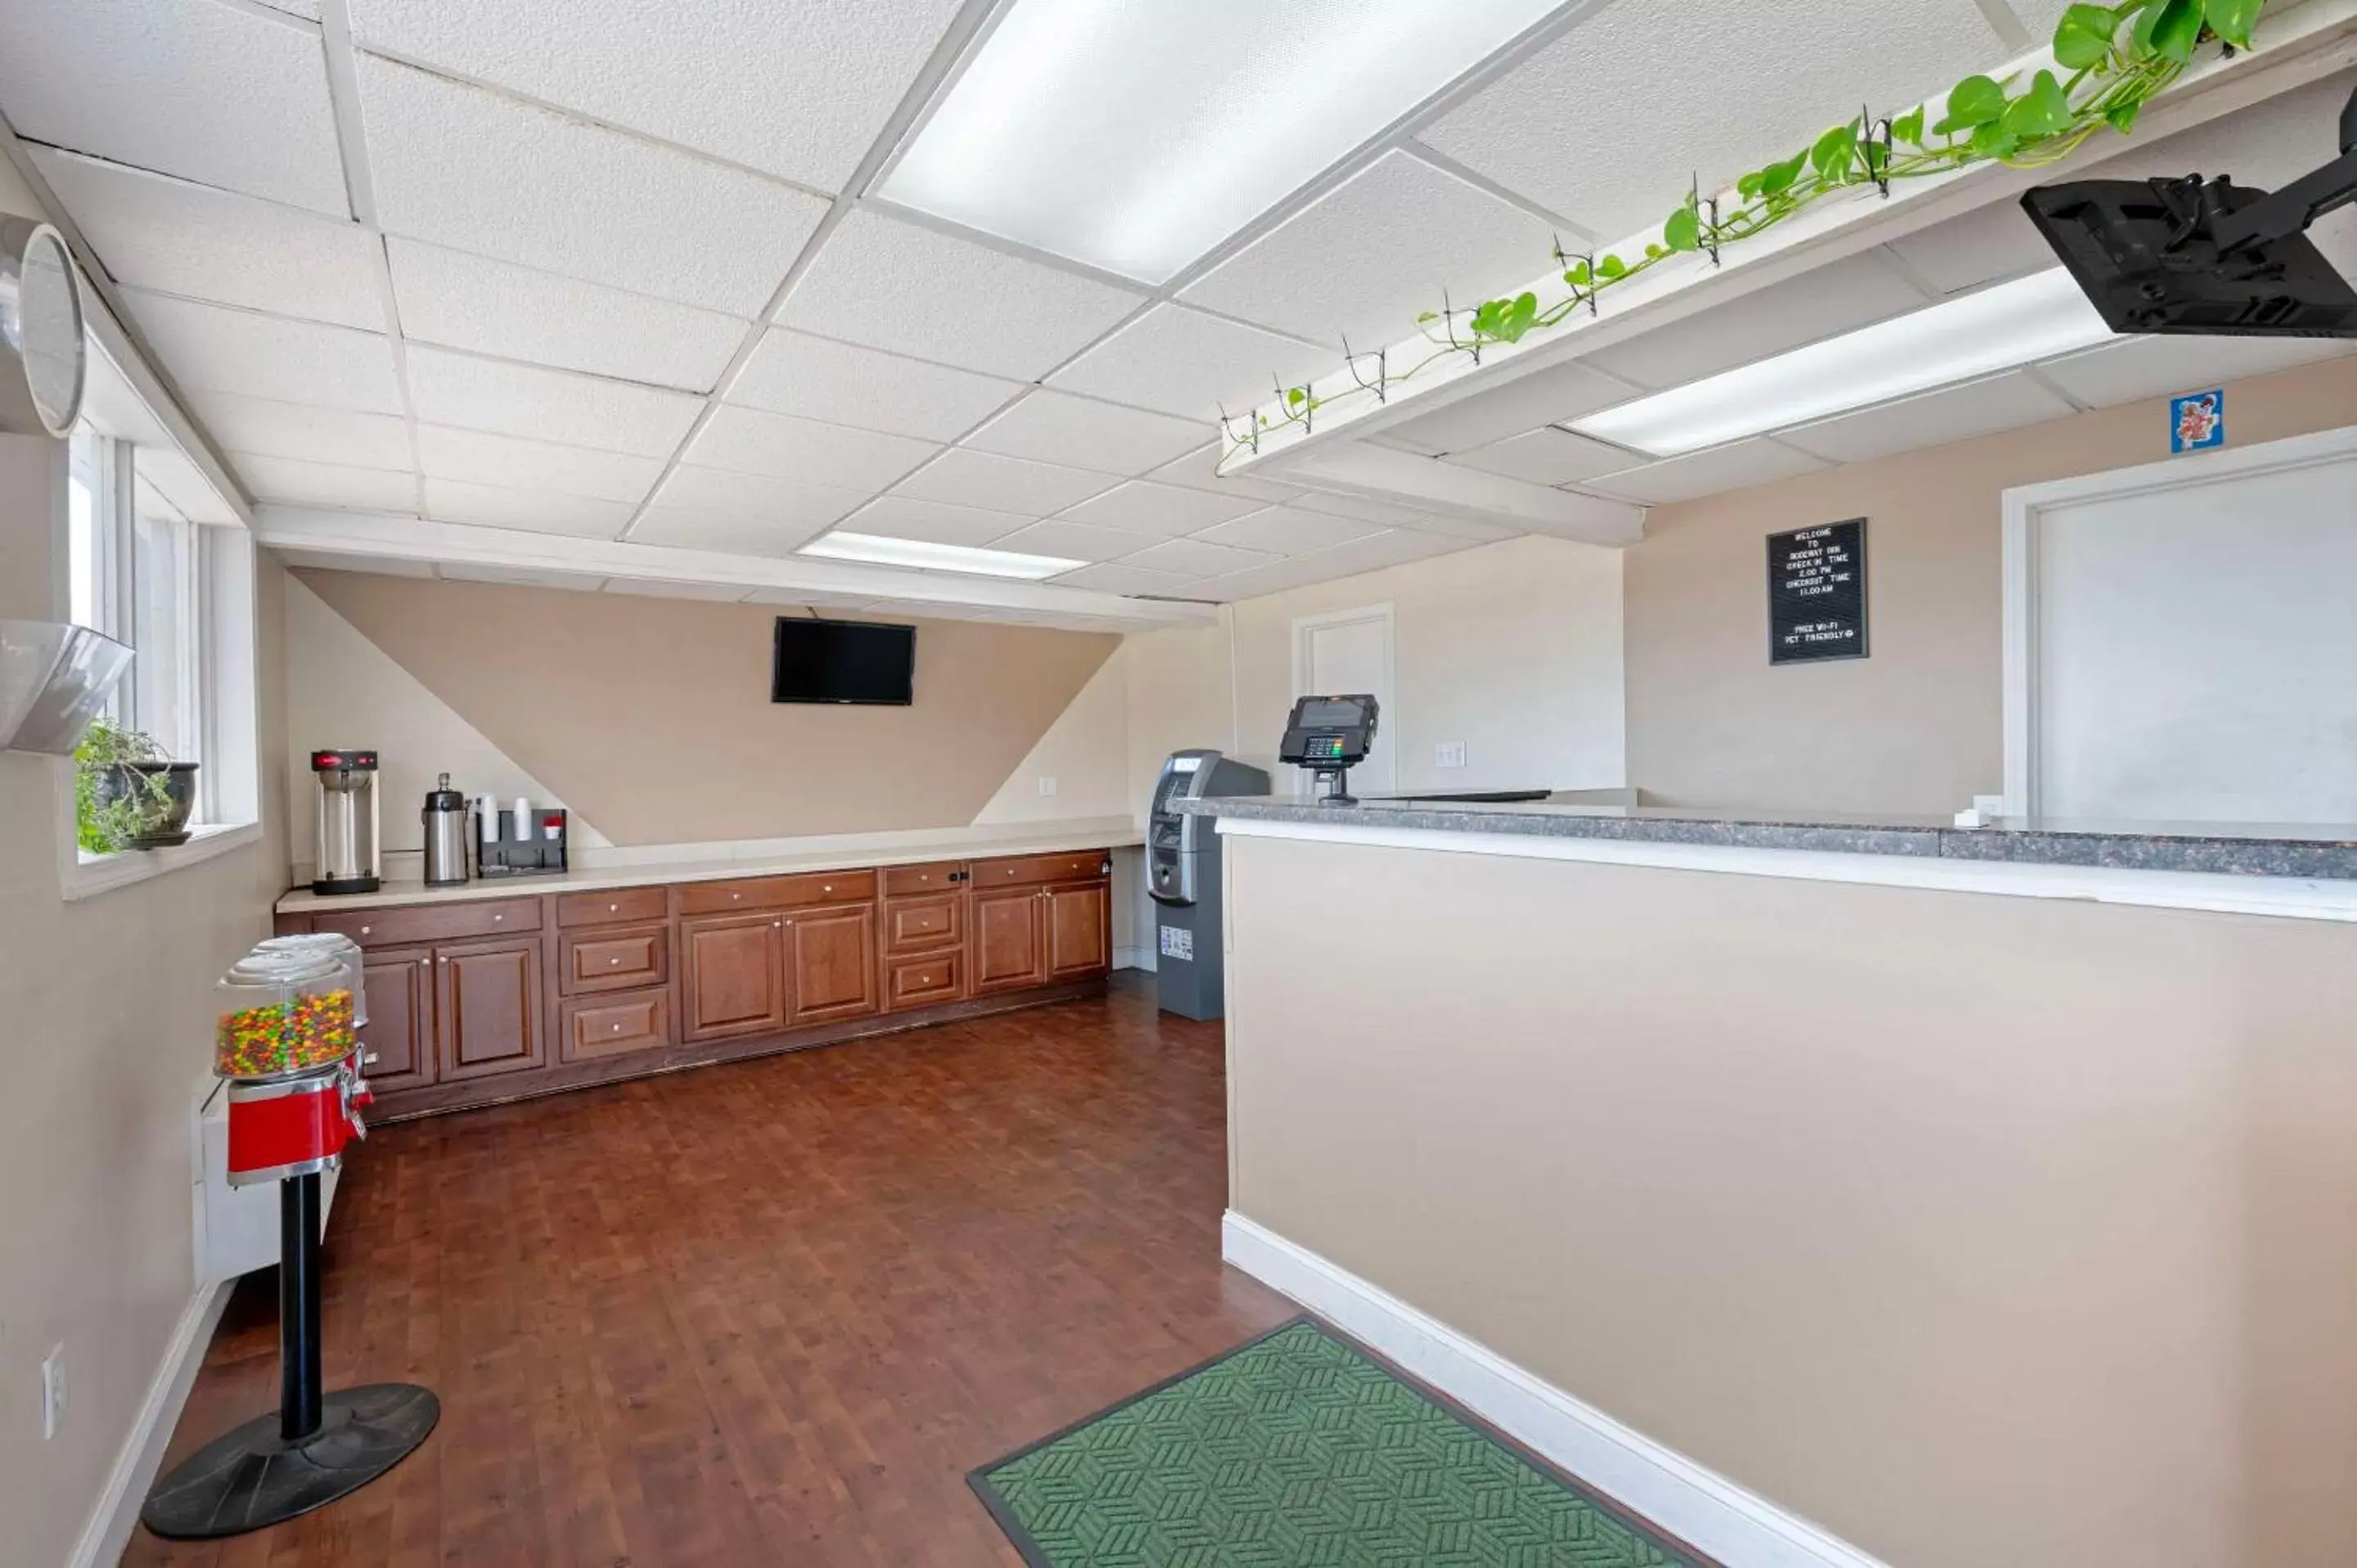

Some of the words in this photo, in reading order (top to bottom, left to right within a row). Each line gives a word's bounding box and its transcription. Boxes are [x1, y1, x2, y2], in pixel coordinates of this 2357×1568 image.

[1829, 553, 1849, 563] TIME
[1829, 573, 1850, 582] TIME
[1821, 584, 1833, 593] AM
[1805, 630, 1845, 642] FRIENDLY
